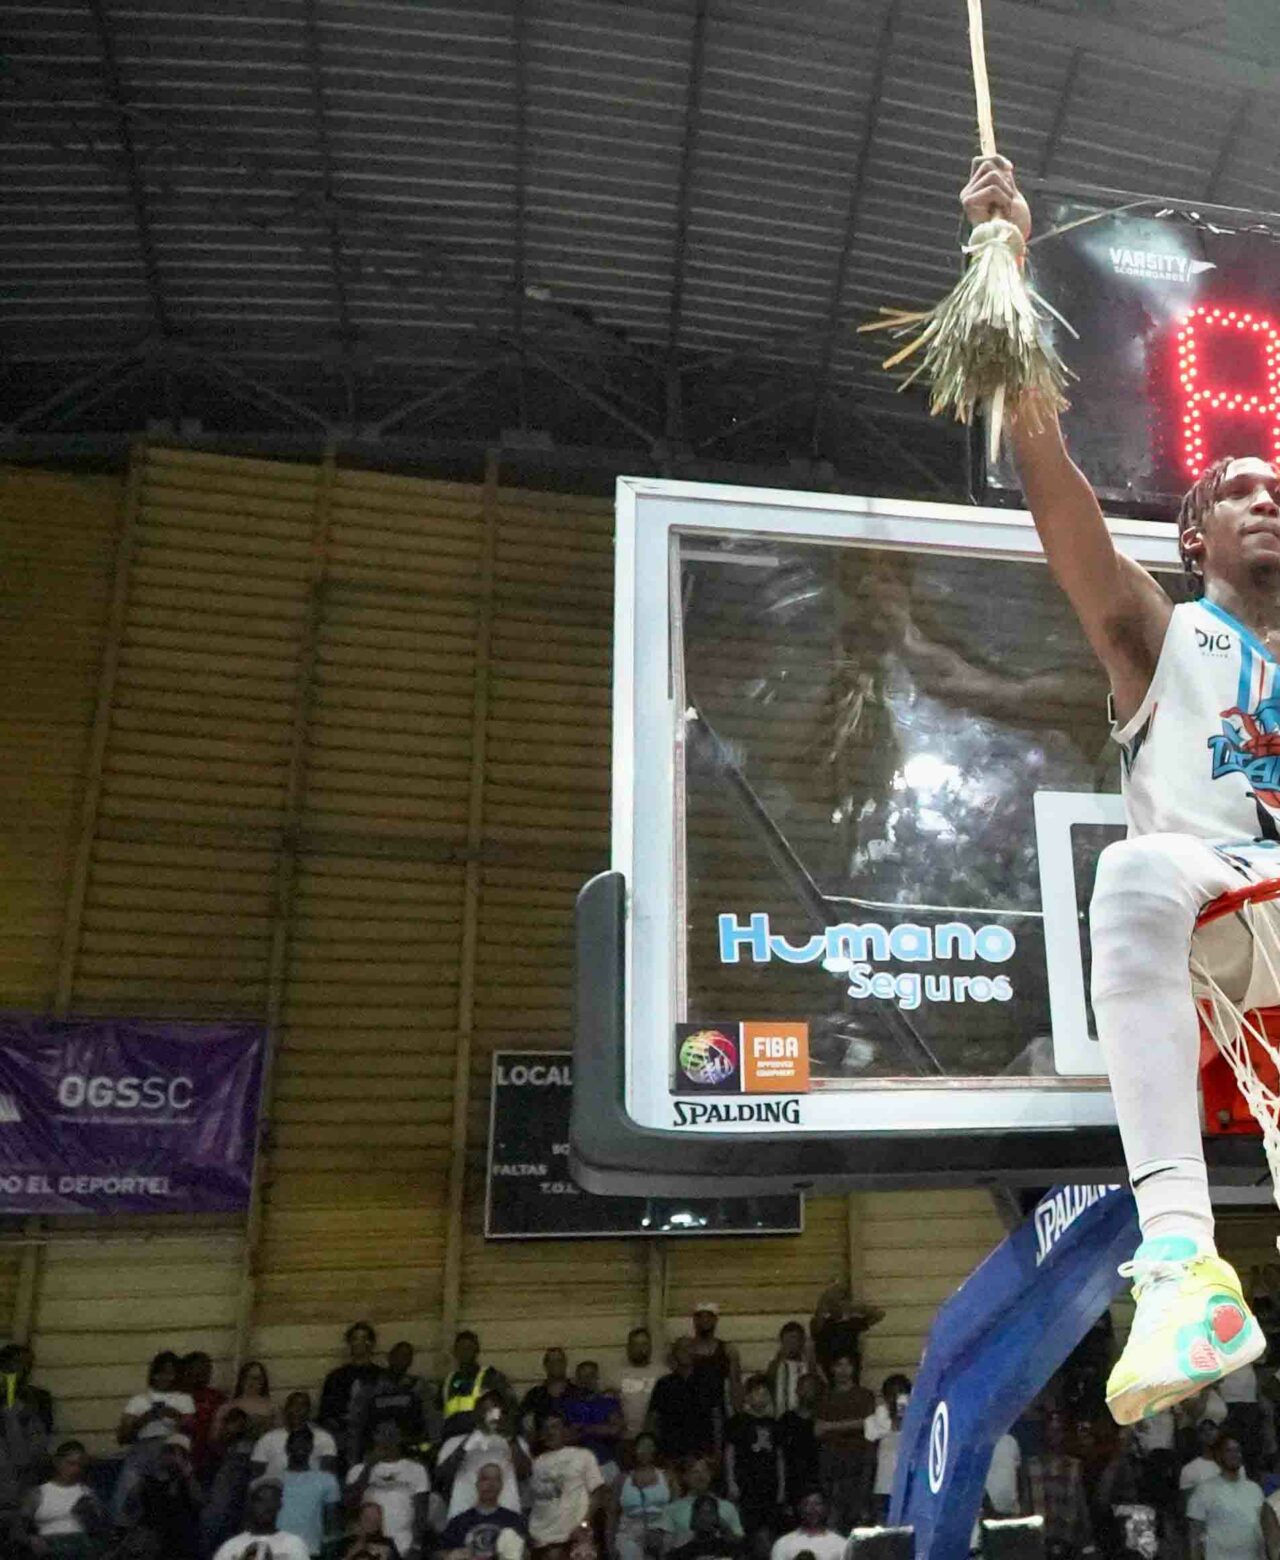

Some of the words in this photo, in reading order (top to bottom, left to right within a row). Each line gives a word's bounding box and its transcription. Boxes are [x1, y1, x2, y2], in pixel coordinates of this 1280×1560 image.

[1108, 247, 1188, 273] VARSITY
[718, 912, 1016, 964] Humano
[847, 962, 1014, 1010] Seguros
[753, 1037, 799, 1058] FIBA
[497, 1064, 573, 1086] LOCAL
[57, 1075, 194, 1109] OGSSC
[672, 1099, 801, 1127] SPALDING
[26, 1175, 54, 1194] EL
